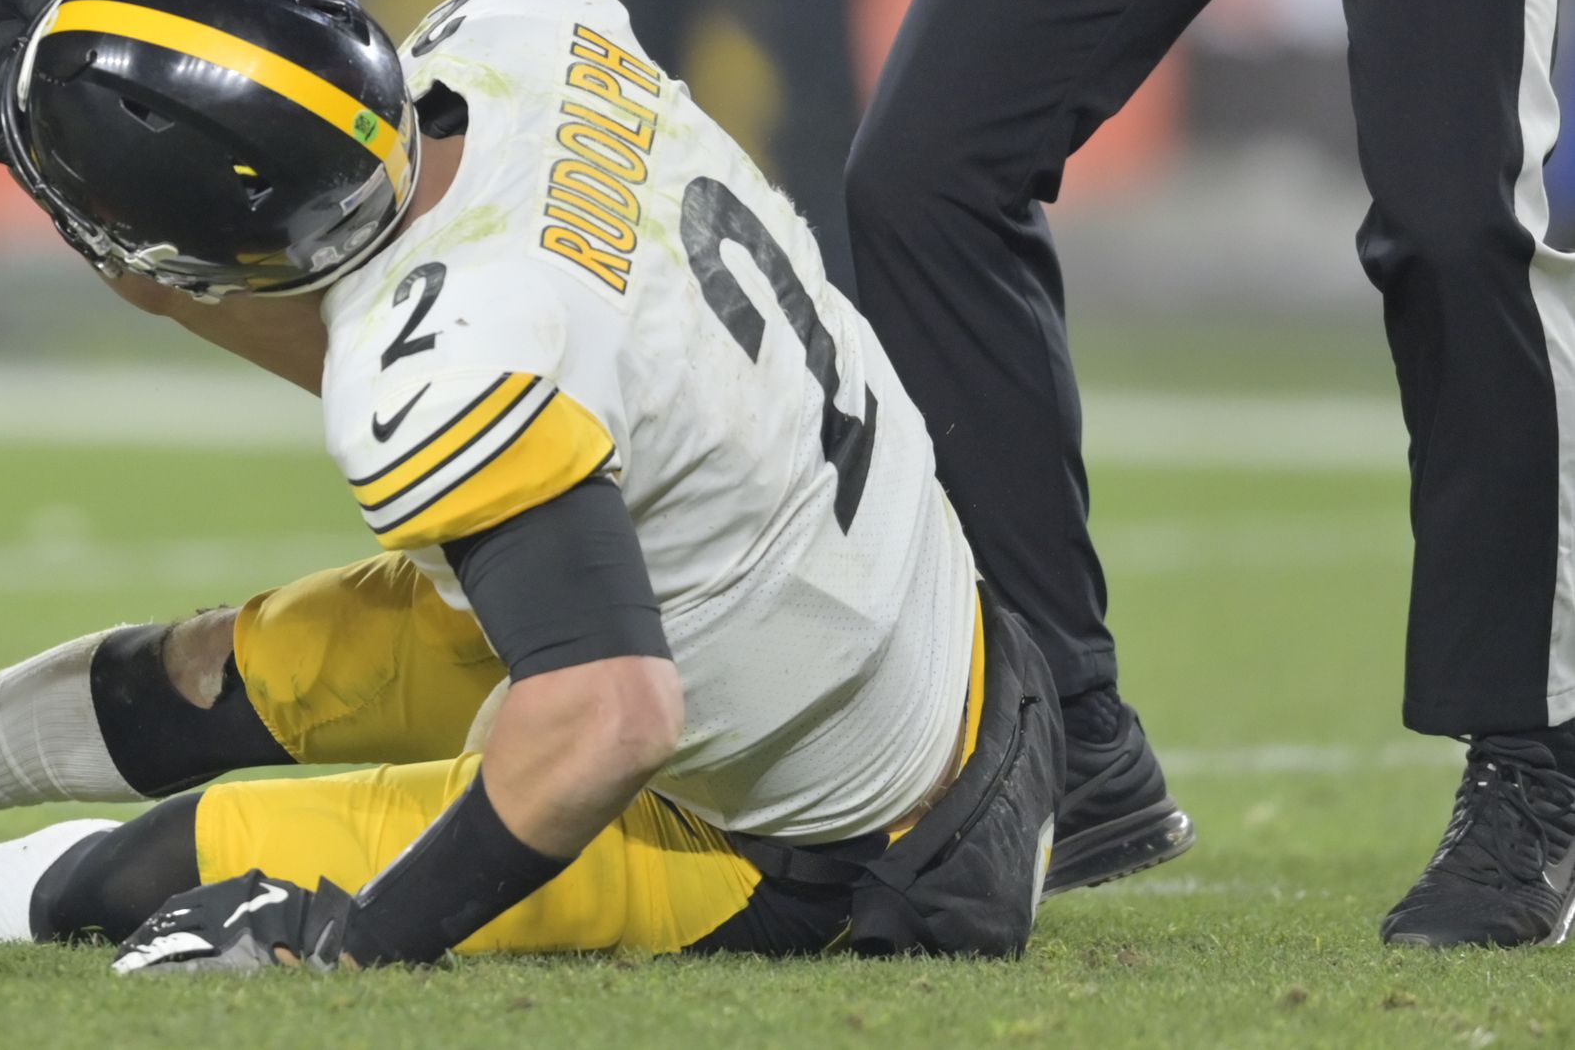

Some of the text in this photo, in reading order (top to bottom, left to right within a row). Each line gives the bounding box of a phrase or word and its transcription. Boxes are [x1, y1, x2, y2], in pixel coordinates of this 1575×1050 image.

[539, 22, 661, 296] RUDOLPH
[380, 261, 447, 372] 2
[680, 176, 878, 536] 2
